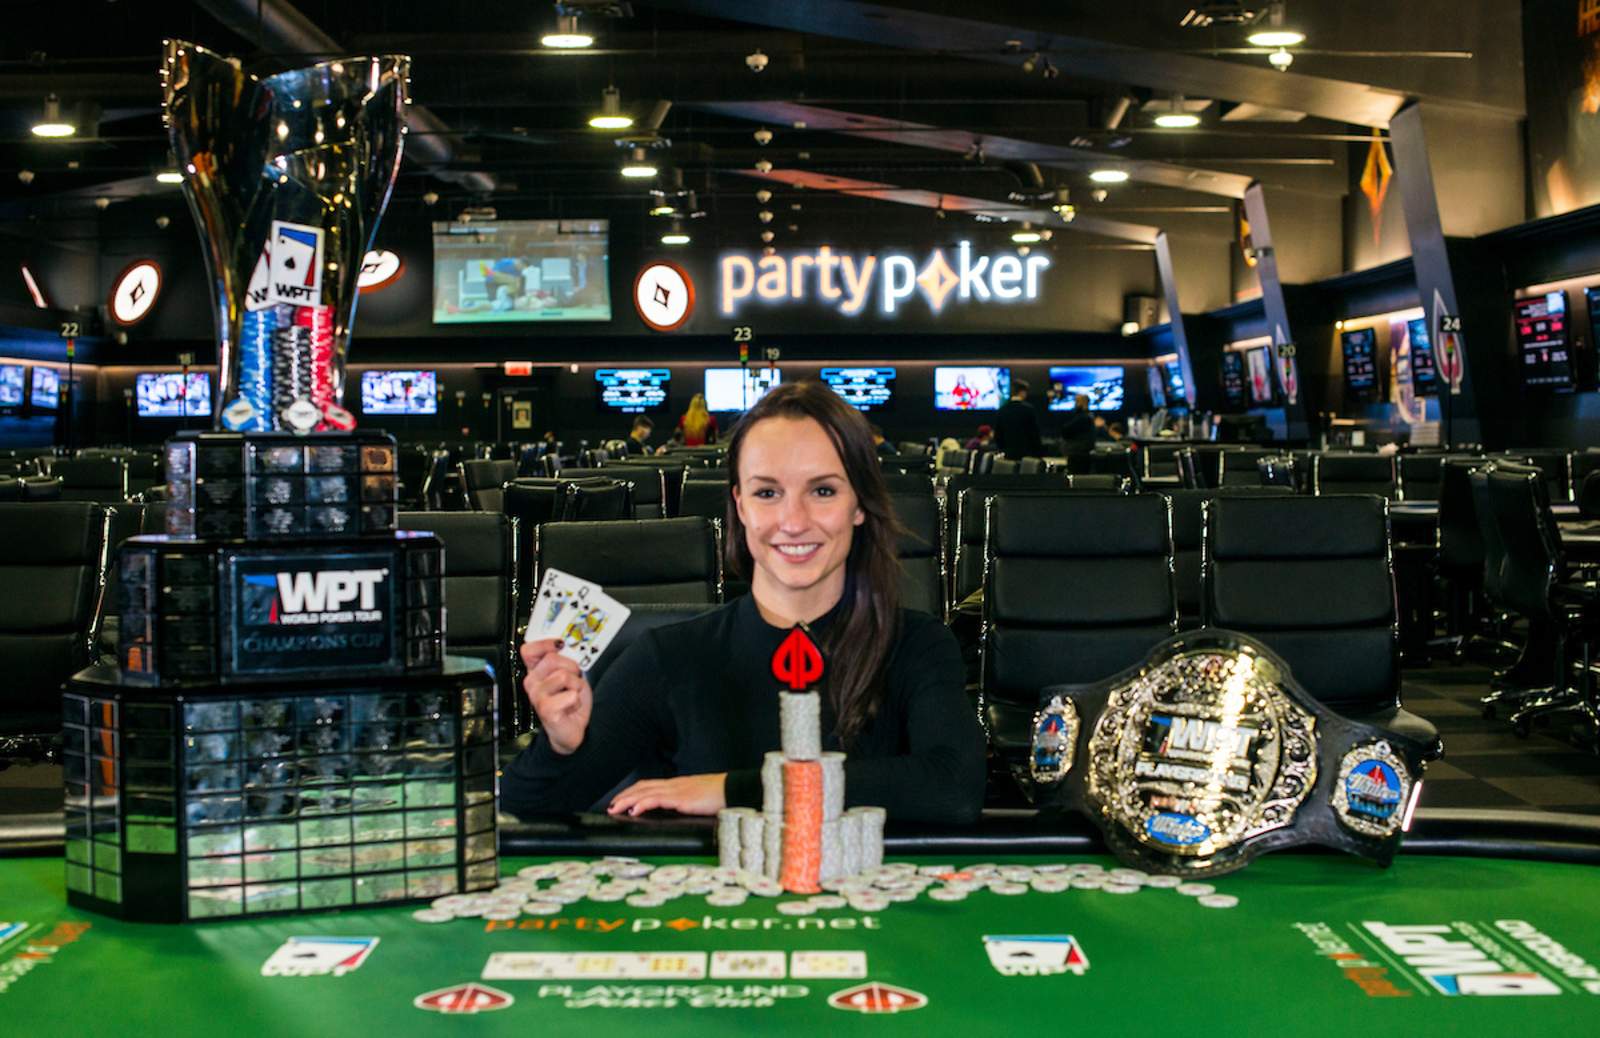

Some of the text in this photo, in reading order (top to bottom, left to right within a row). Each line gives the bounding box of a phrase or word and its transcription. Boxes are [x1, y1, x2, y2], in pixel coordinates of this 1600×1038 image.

[275, 283, 317, 301] WPT
[61, 322, 79, 337] 22
[1442, 317, 1461, 331] 24
[733, 326, 752, 342] 23
[766, 347, 780, 360] 19
[276, 569, 384, 614] WPT
[279, 609, 383, 625] WORLD POKER TOUR
[243, 631, 348, 652] CHAMPIONS
[1361, 920, 1504, 977] WPT
[537, 983, 810, 1000] PLAYGROUND
